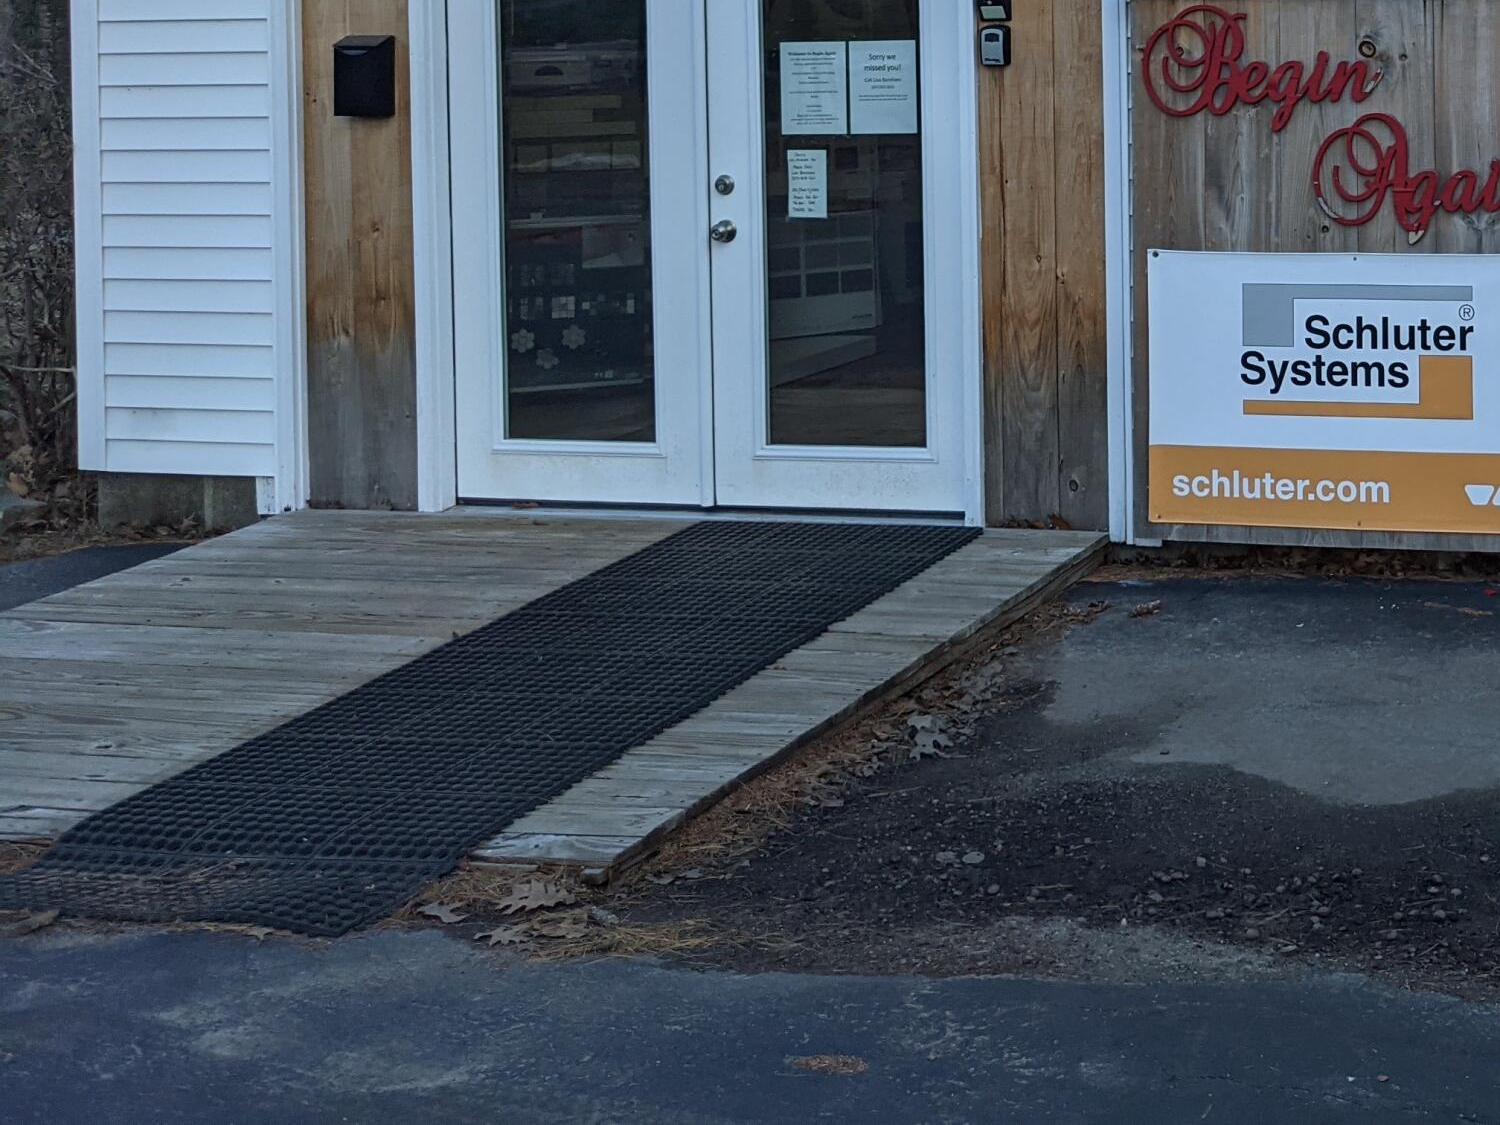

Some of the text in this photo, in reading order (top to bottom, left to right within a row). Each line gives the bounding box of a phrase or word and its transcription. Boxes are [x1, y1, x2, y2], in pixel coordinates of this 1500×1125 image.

[864, 64, 901, 73] missed you!
[868, 53, 886, 62] Sorry
[1141, 4, 1384, 133] Begin
[1304, 315, 1475, 352] Schluter
[1240, 351, 1409, 394] Systems
[1172, 468, 1390, 504] schluter.com
